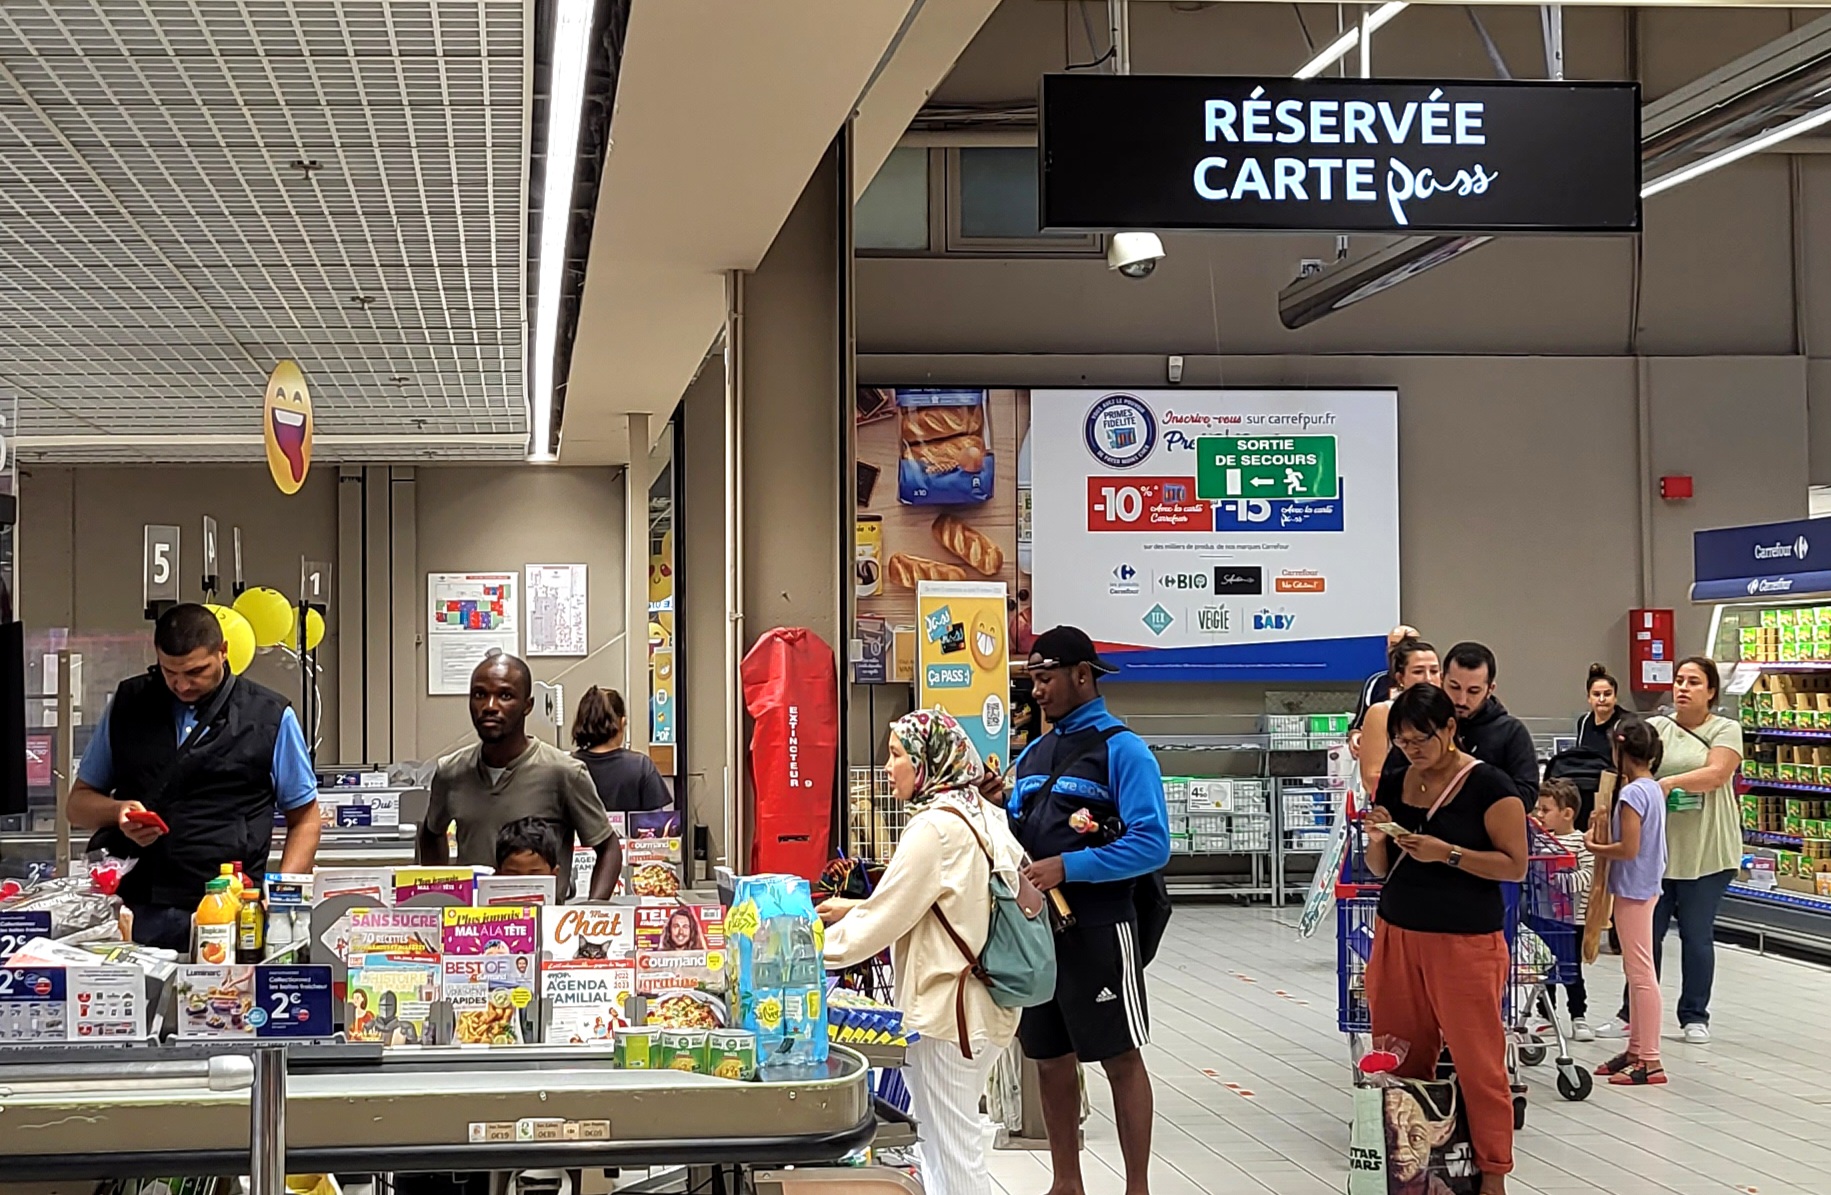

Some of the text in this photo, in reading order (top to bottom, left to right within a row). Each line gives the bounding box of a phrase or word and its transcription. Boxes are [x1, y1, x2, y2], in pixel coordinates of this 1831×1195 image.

[1204, 85, 1486, 145] RÉSERVÉE
[1193, 157, 1499, 225] CARTE pass
[1103, 408, 1134, 420] PRIMES
[1247, 415, 1266, 425] sur
[1237, 439, 1295, 451] SORTIE
[1215, 453, 1318, 466] DE SECOURS
[1754, 542, 1792, 559] Carrefour
[153, 543, 170, 584] 5
[309, 572, 320, 595] 1
[1759, 578, 1793, 592] Carrefour
[1253, 614, 1296, 630] BABY
[928, 669, 940, 686] Ça
[941, 669, 964, 683] PASS
[789, 706, 799, 787] EXTINCTEUR
[352, 914, 438, 928] SANS SUCRE
[456, 910, 520, 926] Plus jamais
[454, 926, 480, 937] MAL
[489, 925, 503, 936] LA
[504, 922, 527, 937] TÊTE
[555, 910, 623, 944] Chat
[363, 932, 409, 944] 70 RECETTES
[445, 960, 508, 974] BEST OF
[639, 951, 707, 969] Gourmand
[186, 968, 221, 977] Luminarc
[546, 979, 608, 991] AGENDA
[270, 992, 302, 1019] 2€
[446, 996, 487, 1005] RAPIDES
[547, 992, 612, 1004] FAMILIAL
